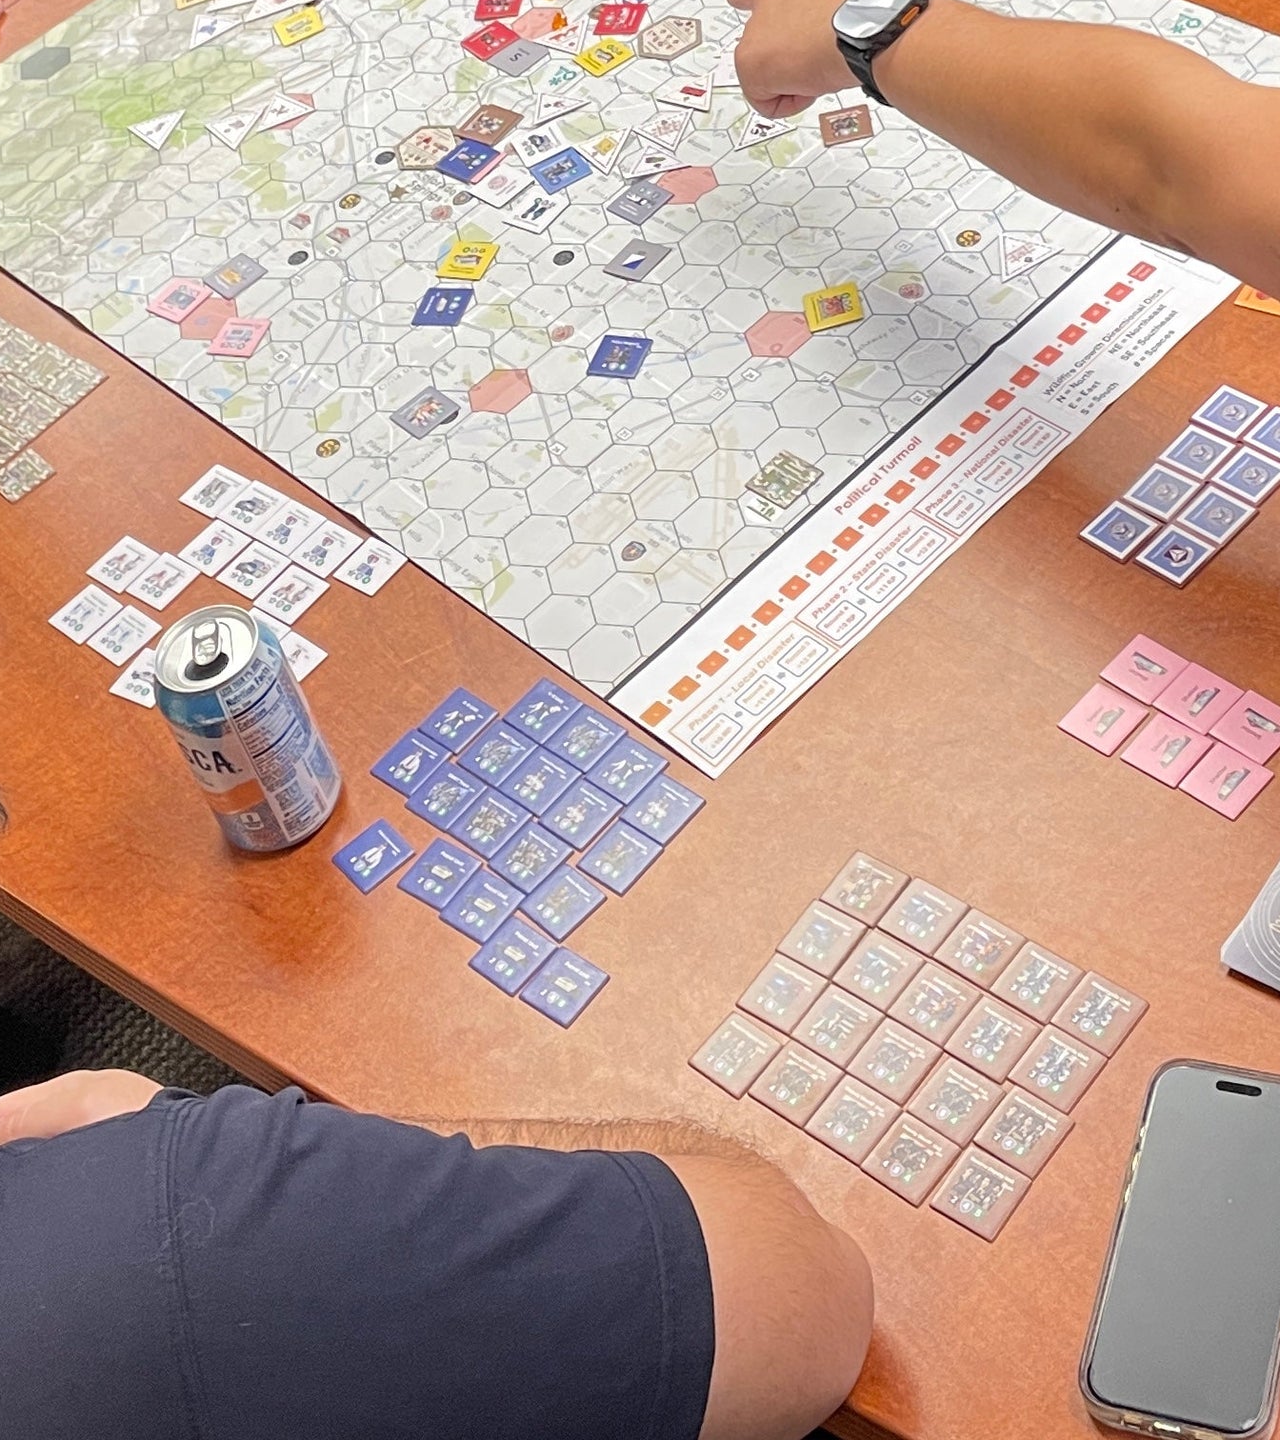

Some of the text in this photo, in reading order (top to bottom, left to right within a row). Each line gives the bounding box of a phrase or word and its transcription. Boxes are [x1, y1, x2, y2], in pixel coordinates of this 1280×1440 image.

[1073, 339, 1105, 369] Growth
[1101, 302, 1146, 343] Directional
[1125, 301, 1167, 340] Northeast
[1136, 307, 1179, 347] Southeast
[1144, 327, 1177, 358] Spaces
[1069, 366, 1095, 391] North
[1080, 378, 1101, 398] East
[1092, 379, 1119, 404] South
[833, 434, 923, 517] Political Turmoil
[924, 486, 953, 514] Phase
[962, 443, 1000, 479] National
[997, 413, 1034, 447] Disaster
[810, 590, 841, 619] Phase
[851, 557, 877, 582] State
[874, 524, 913, 560] Disaster
[223, 665, 272, 708] Nutrition Facts
[687, 701, 719, 731] Phase
[730, 666, 758, 693] Local
[755, 631, 796, 670] Disaster
